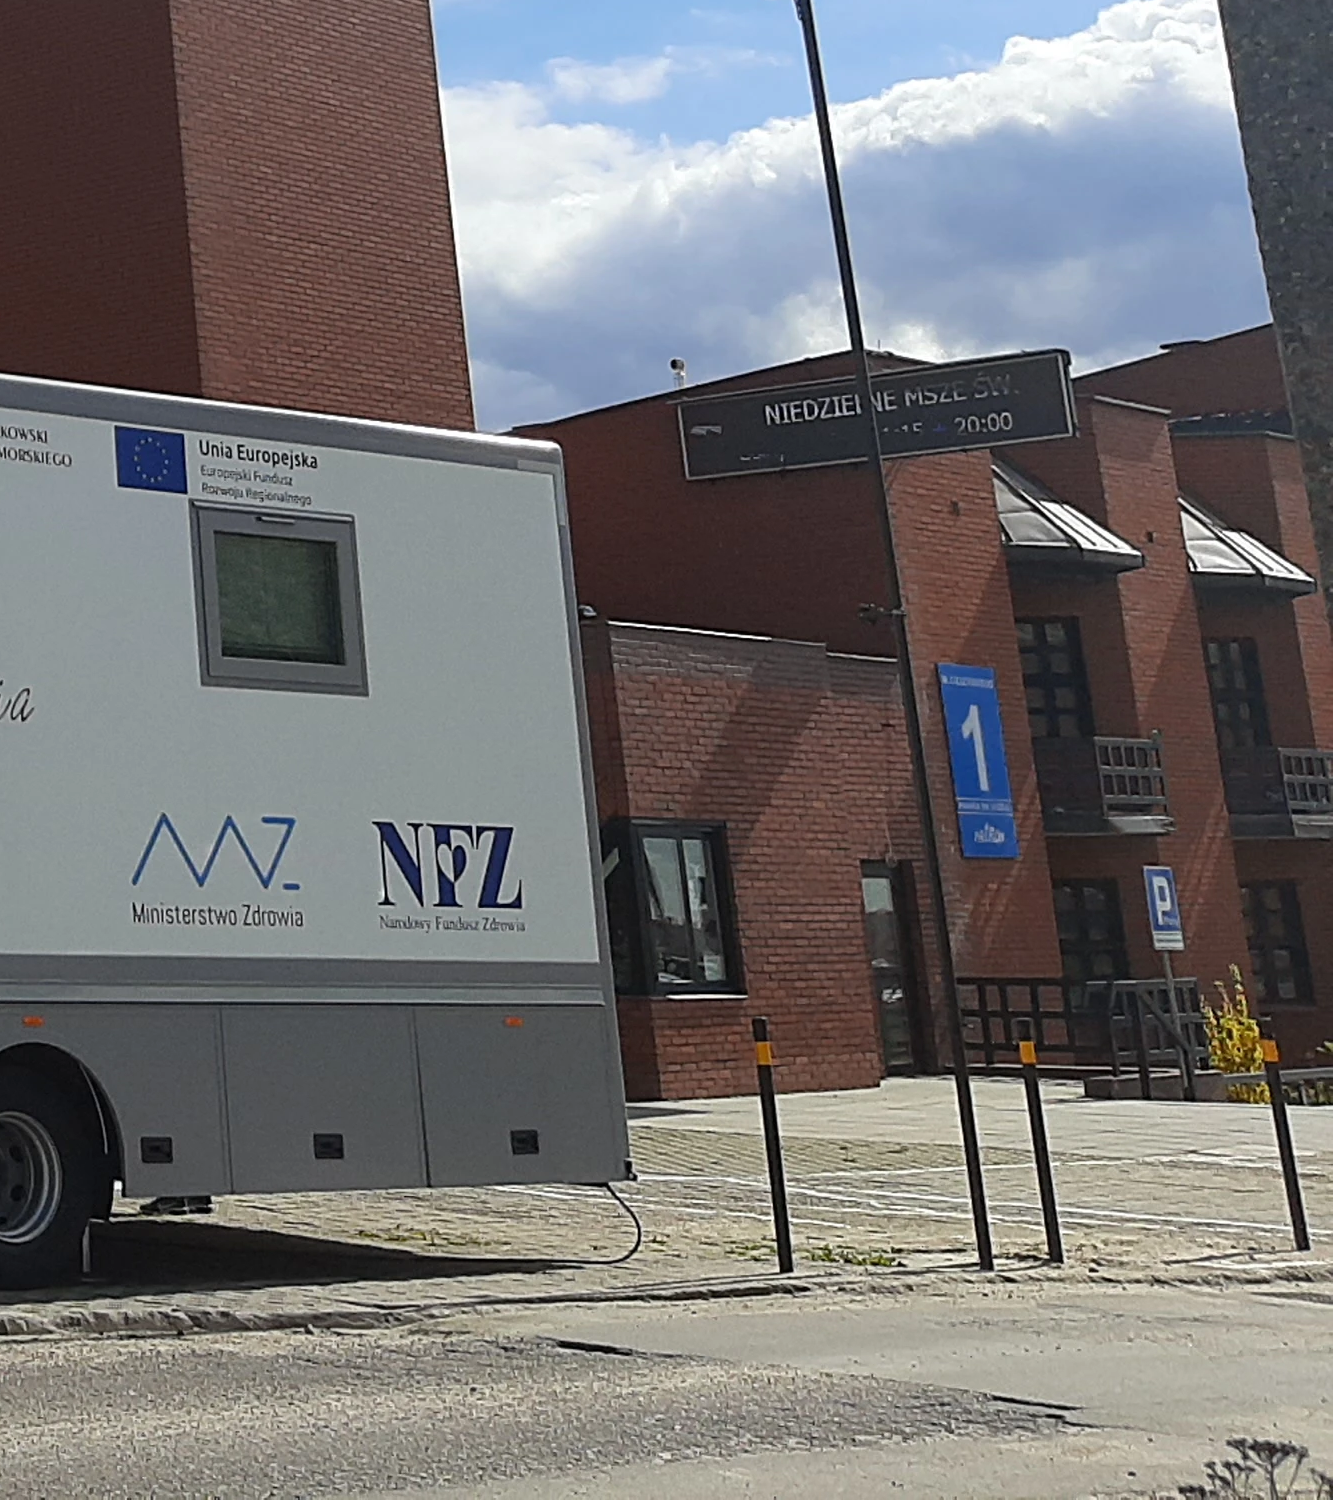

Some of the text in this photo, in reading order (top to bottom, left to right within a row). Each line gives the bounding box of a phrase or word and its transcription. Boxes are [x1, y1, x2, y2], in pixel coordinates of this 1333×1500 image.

[954, 411, 1013, 435] 20:00
[199, 439, 318, 469] Unia Europejska
[961, 704, 989, 792] 1
[371, 820, 523, 909] NFZ
[132, 902, 304, 927] Ministerstwo Zdrowia
[1153, 876, 1171, 926] P
